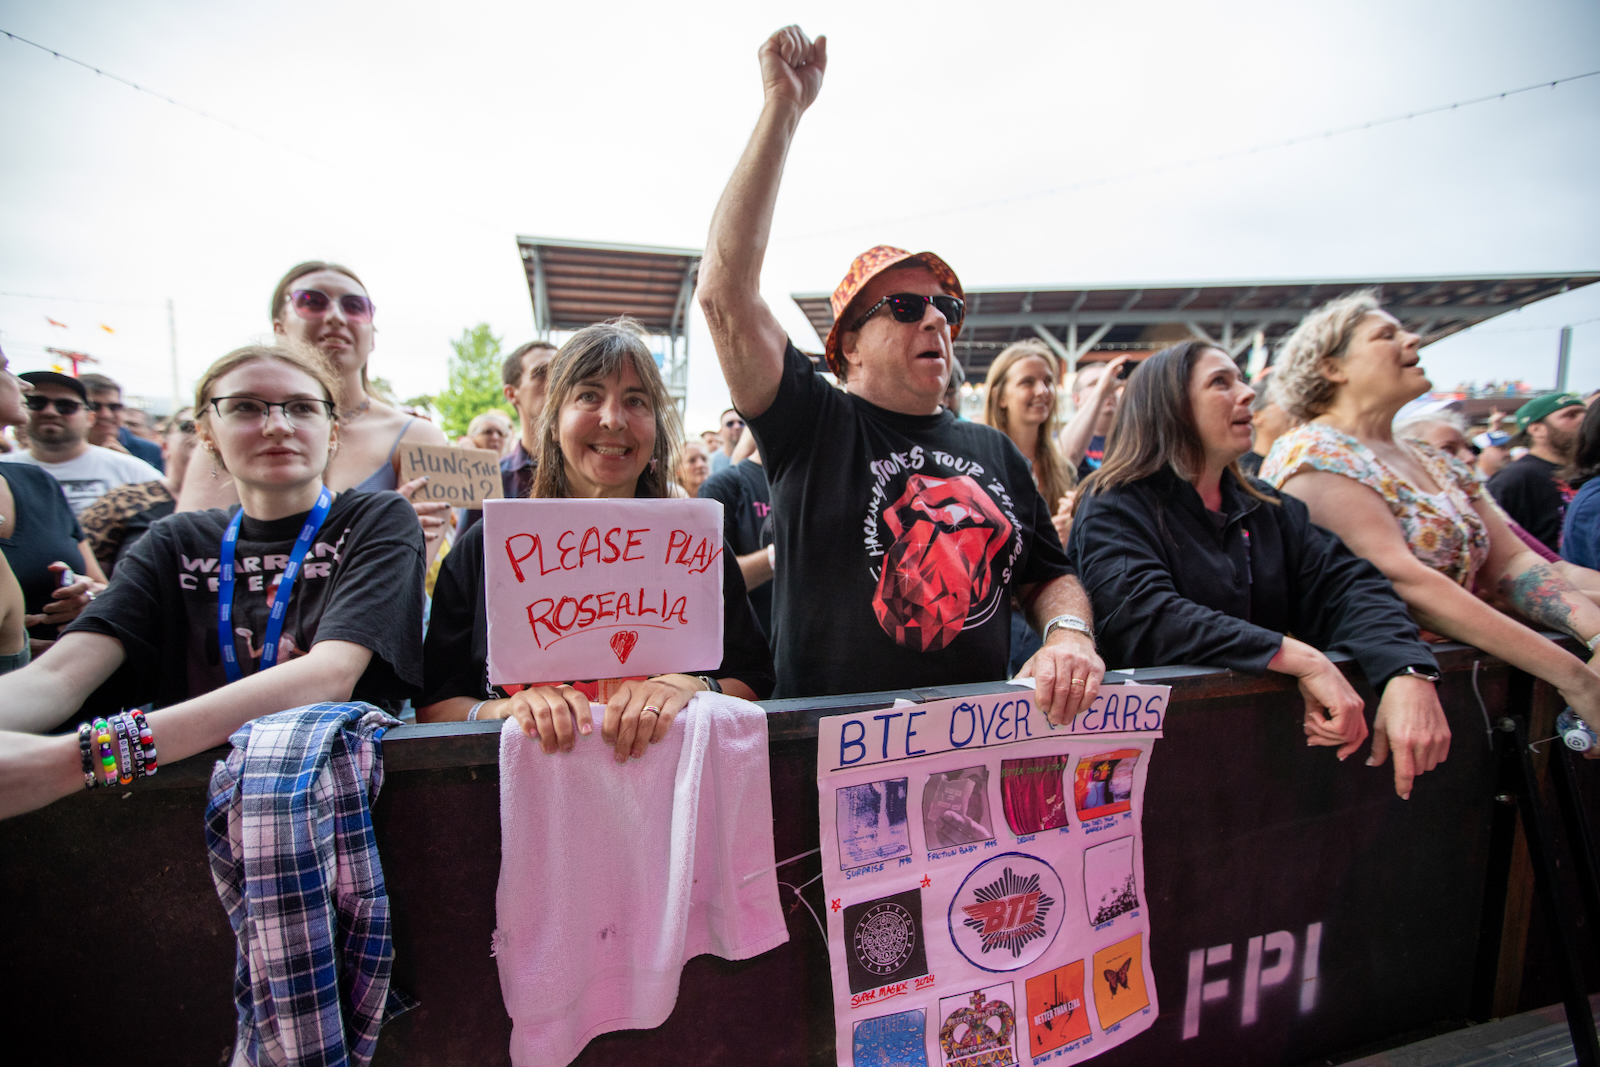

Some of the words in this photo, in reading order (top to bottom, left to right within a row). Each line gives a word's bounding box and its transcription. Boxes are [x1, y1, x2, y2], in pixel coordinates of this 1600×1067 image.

[408, 447, 472, 479] HUNG
[472, 461, 498, 476] THE
[870, 445, 925, 486] STONES
[932, 451, 985, 477] TOUR
[505, 527, 650, 583] PLEASE
[664, 530, 724, 574] PLAY
[526, 588, 688, 648] ROSEALIA
[114, 722, 132, 779] BLOSSOMS
[840, 711, 927, 766] BTE
[950, 699, 1033, 748] OVER
[846, 863, 884, 879] SURPRISE
[958, 845, 977, 855] BABY
[968, 890, 1041, 936] BTE
[851, 990, 875, 1005] SUPER
[915, 975, 934, 987] 2024
[1182, 921, 1322, 1040] FPI
[1034, 1009, 1054, 1026] BETTER
[1054, 1003, 1068, 1017] THAN
[1068, 998, 1080, 1011] EZRA
